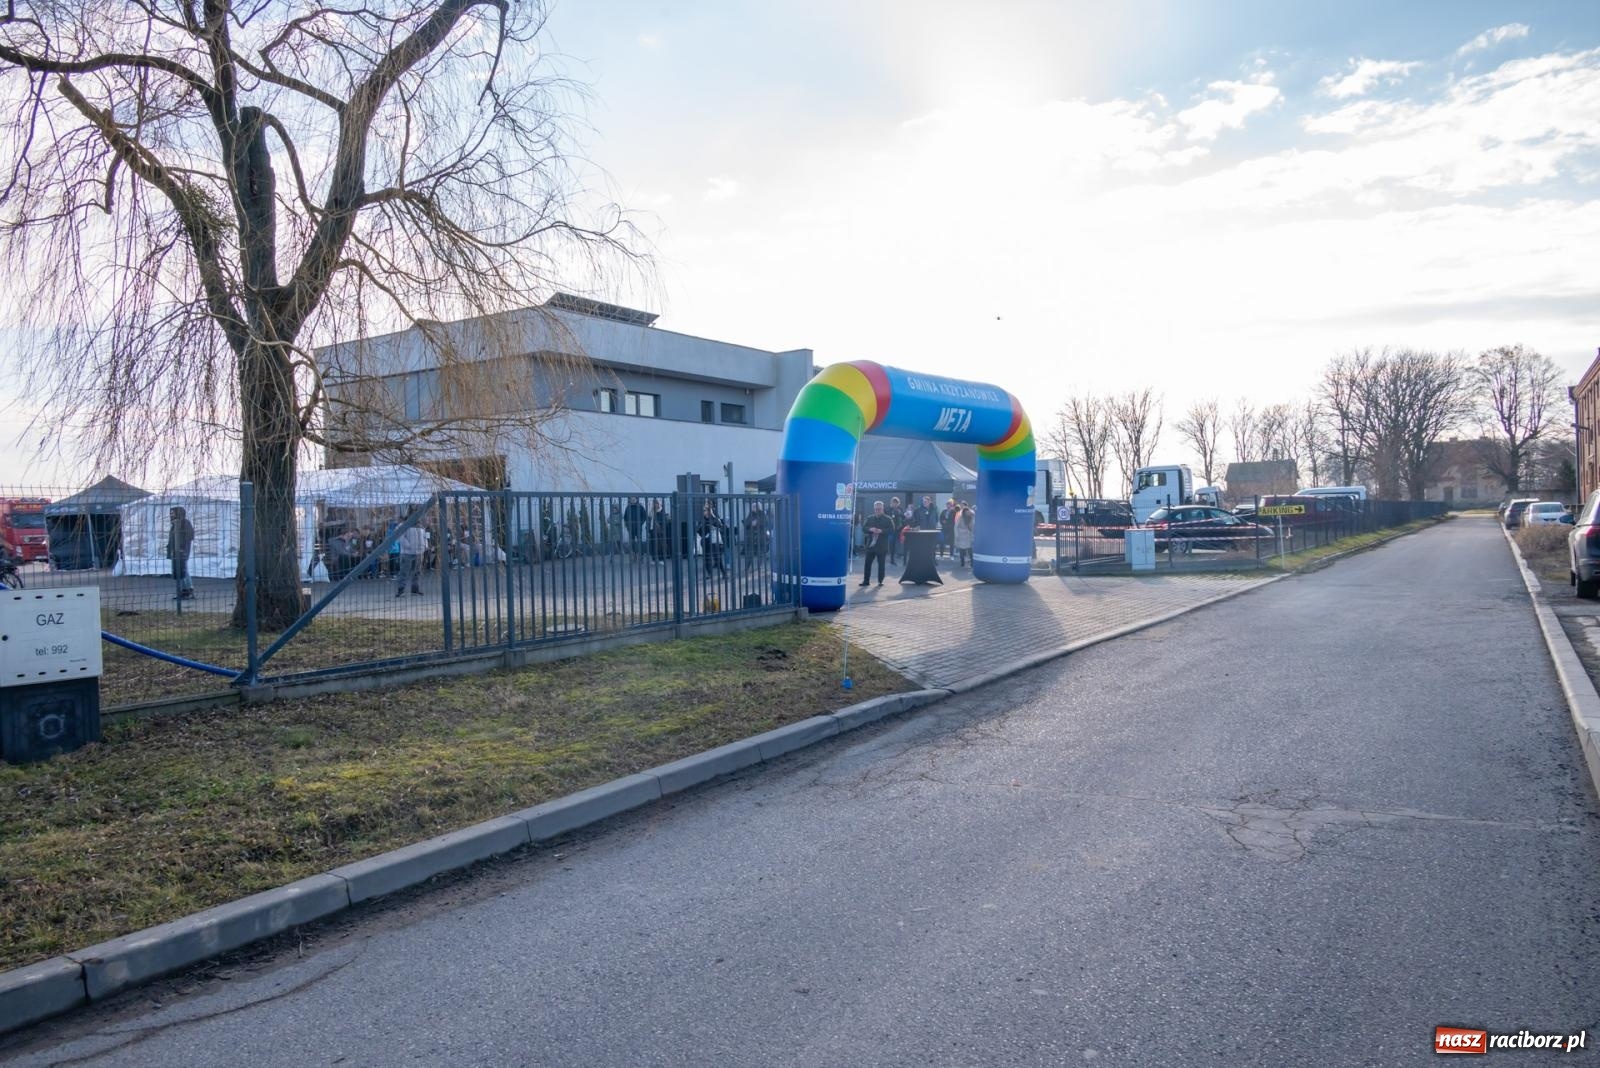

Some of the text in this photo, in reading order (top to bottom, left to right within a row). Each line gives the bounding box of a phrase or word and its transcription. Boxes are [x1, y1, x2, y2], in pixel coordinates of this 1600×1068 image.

[907, 376, 939, 393] GMINA
[933, 407, 972, 432] META
[36, 613, 65, 626] GAZ
[35, 644, 69, 656] tel: 992
